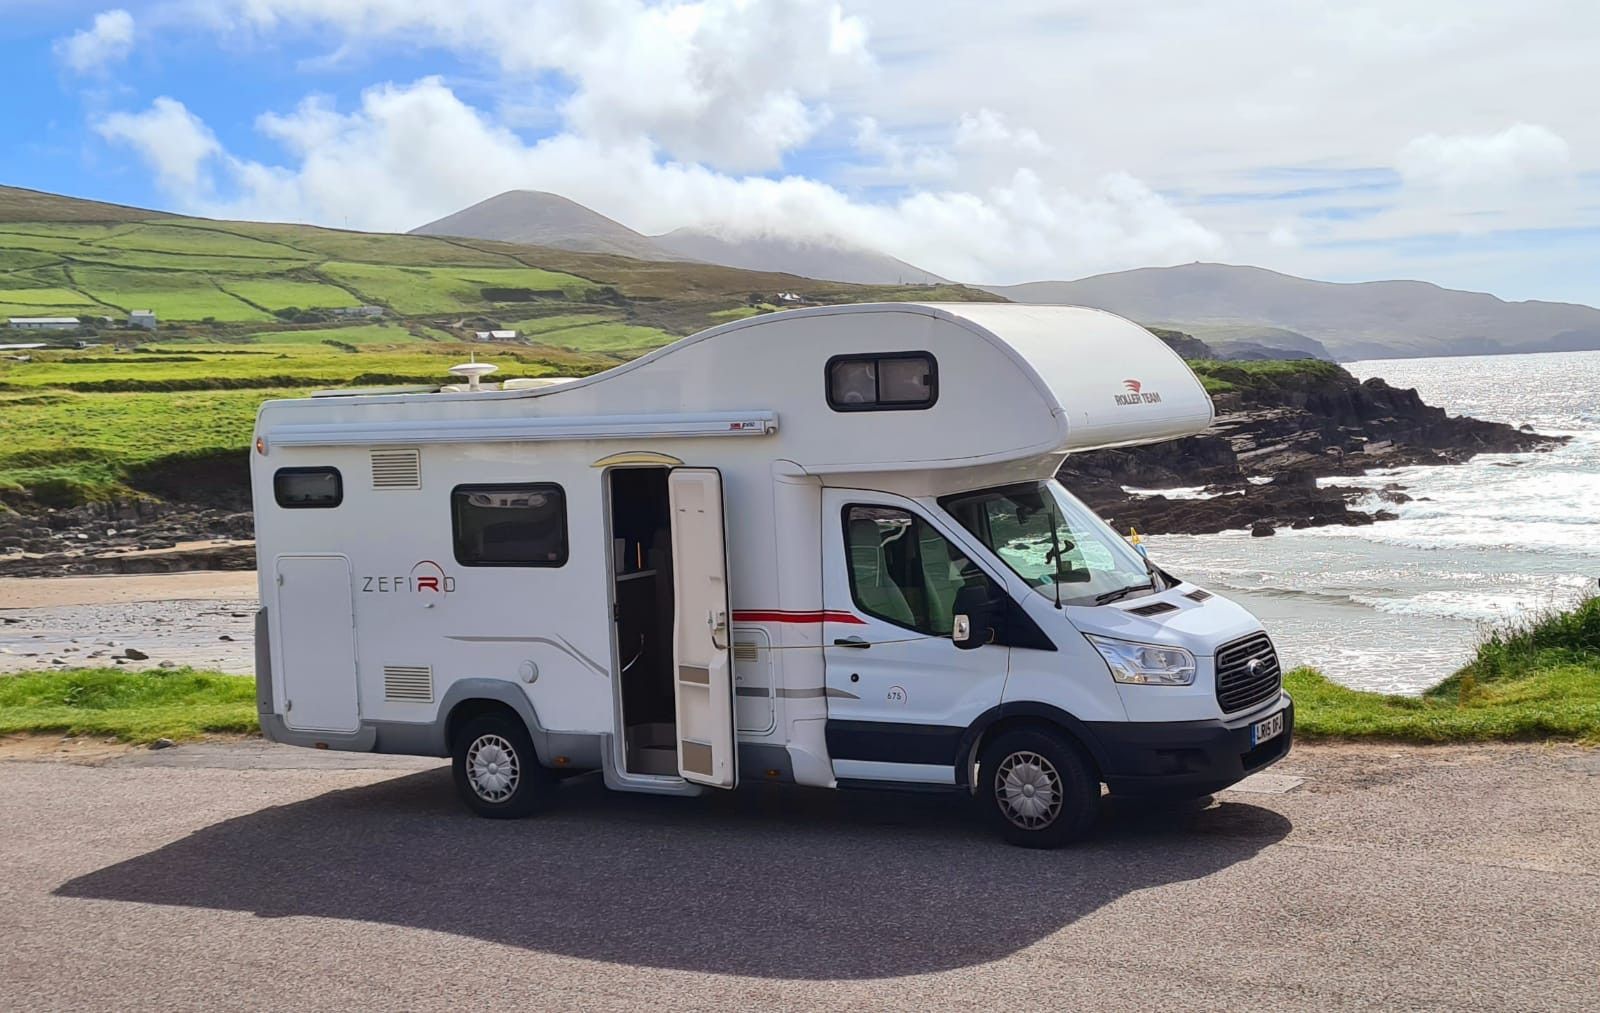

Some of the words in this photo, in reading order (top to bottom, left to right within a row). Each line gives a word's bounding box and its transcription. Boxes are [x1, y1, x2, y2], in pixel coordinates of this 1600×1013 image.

[1114, 393, 1142, 406] ROLLER
[1141, 391, 1161, 404] TEAM
[362, 576, 455, 592] ZEFIRO
